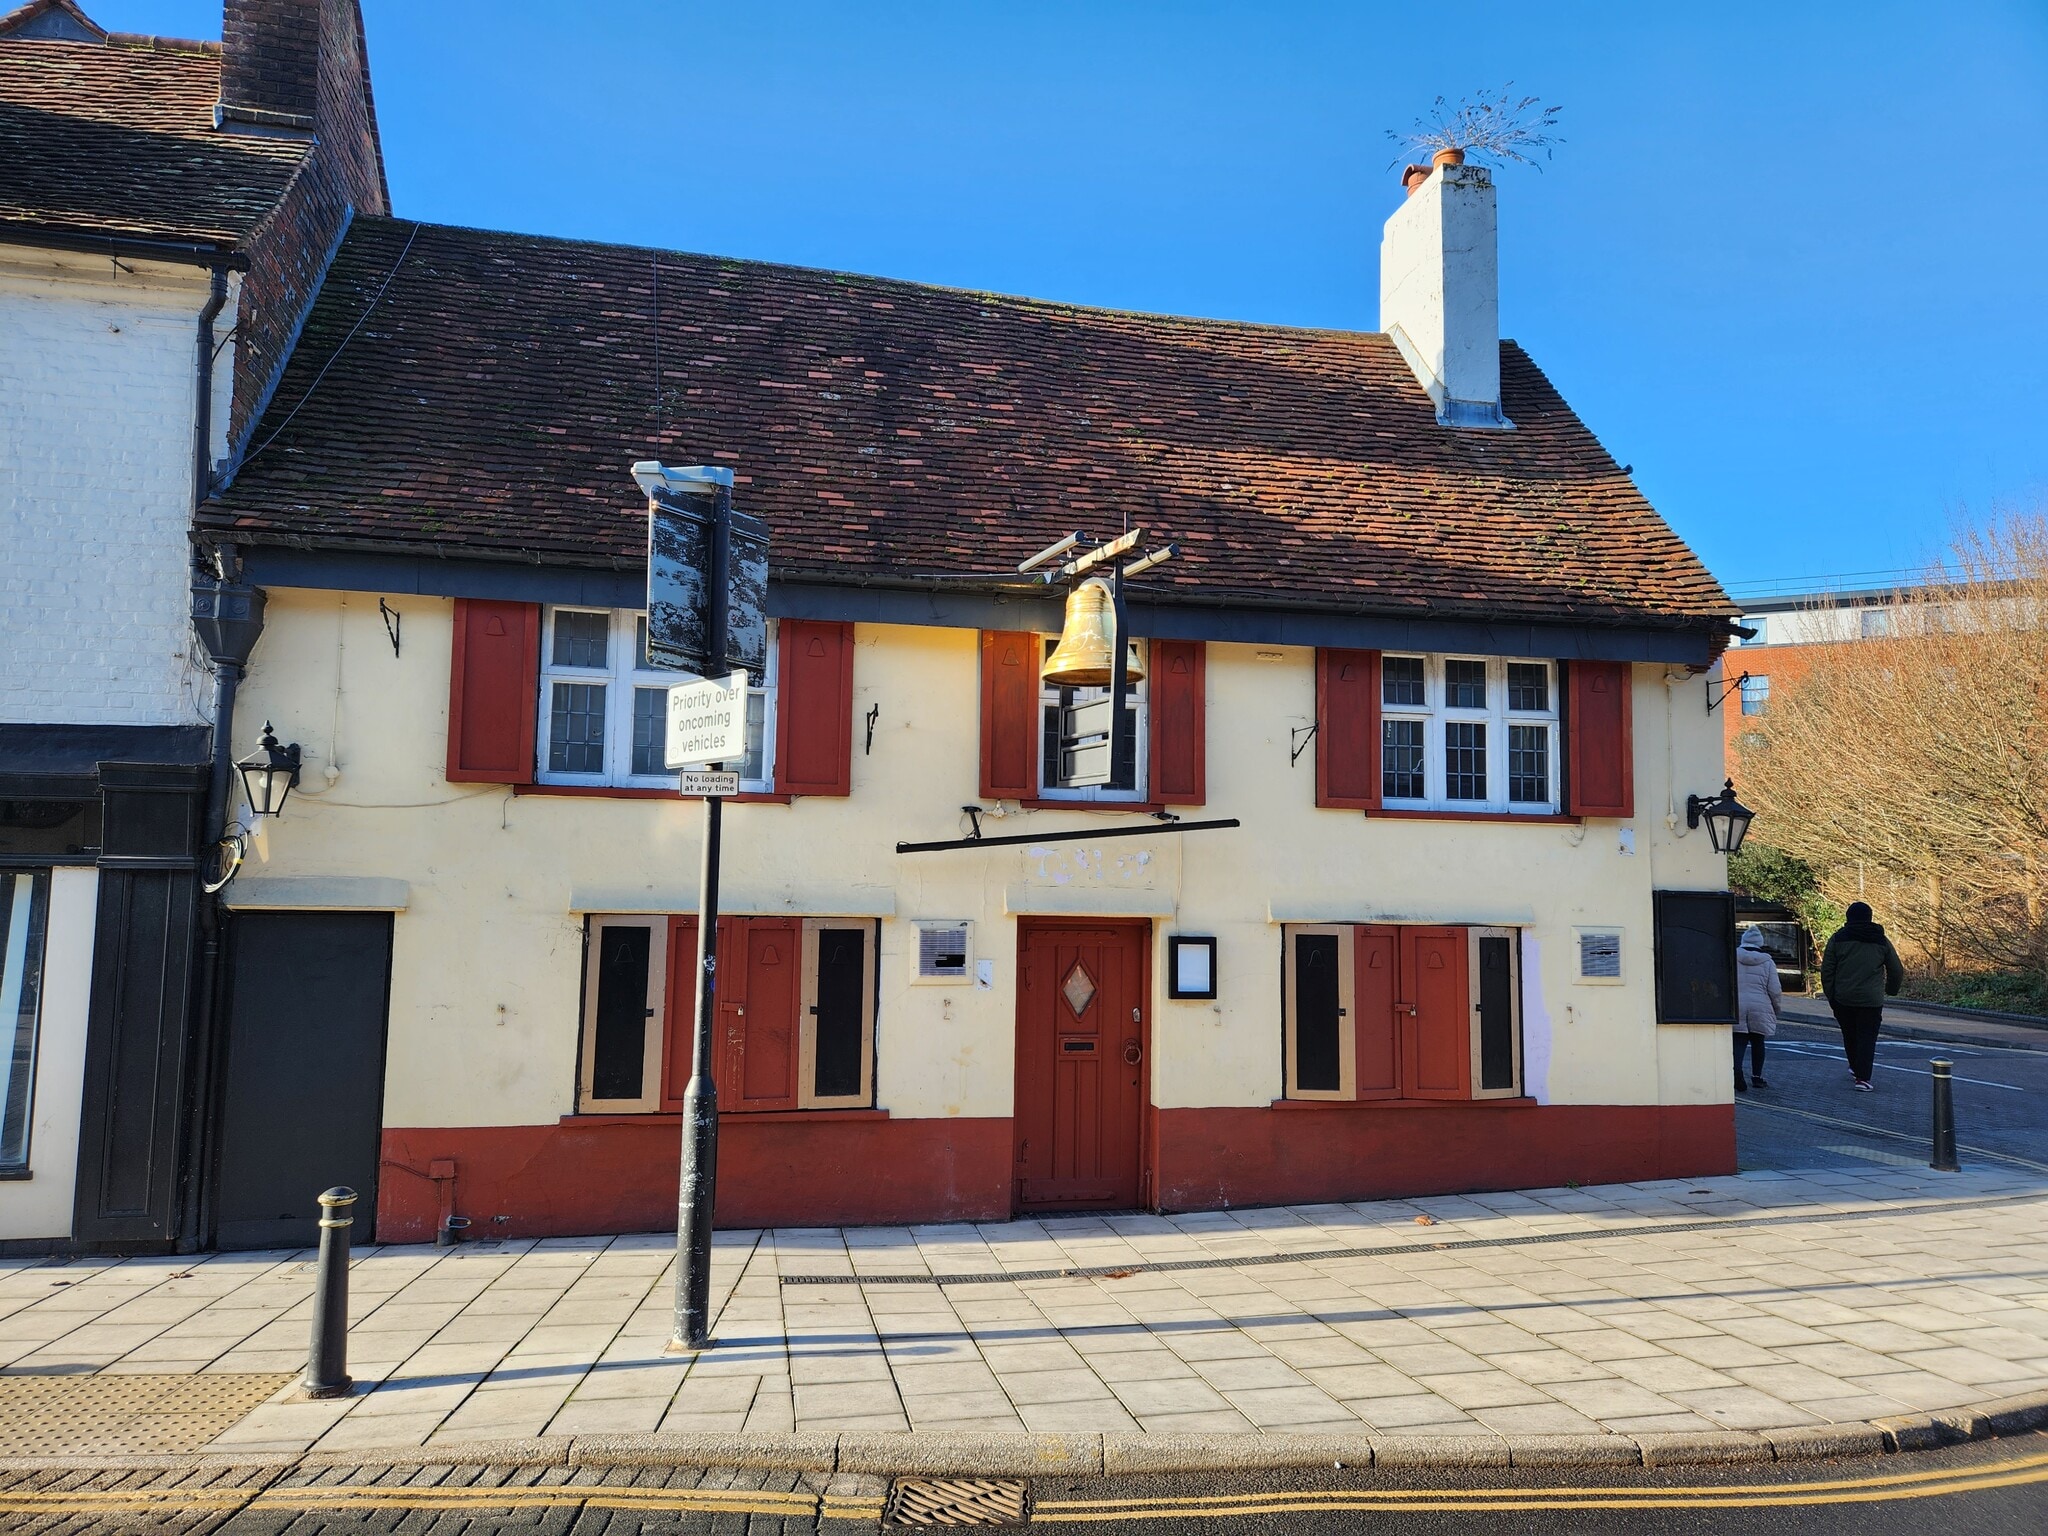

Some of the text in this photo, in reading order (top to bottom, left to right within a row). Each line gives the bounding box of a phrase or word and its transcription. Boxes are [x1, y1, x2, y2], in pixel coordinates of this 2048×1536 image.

[673, 687, 740, 711] Priority over
[679, 710, 731, 732] oncoming
[682, 733, 726, 752] vehicles
[684, 784, 735, 793] at any time
[686, 775, 734, 784] No loading
